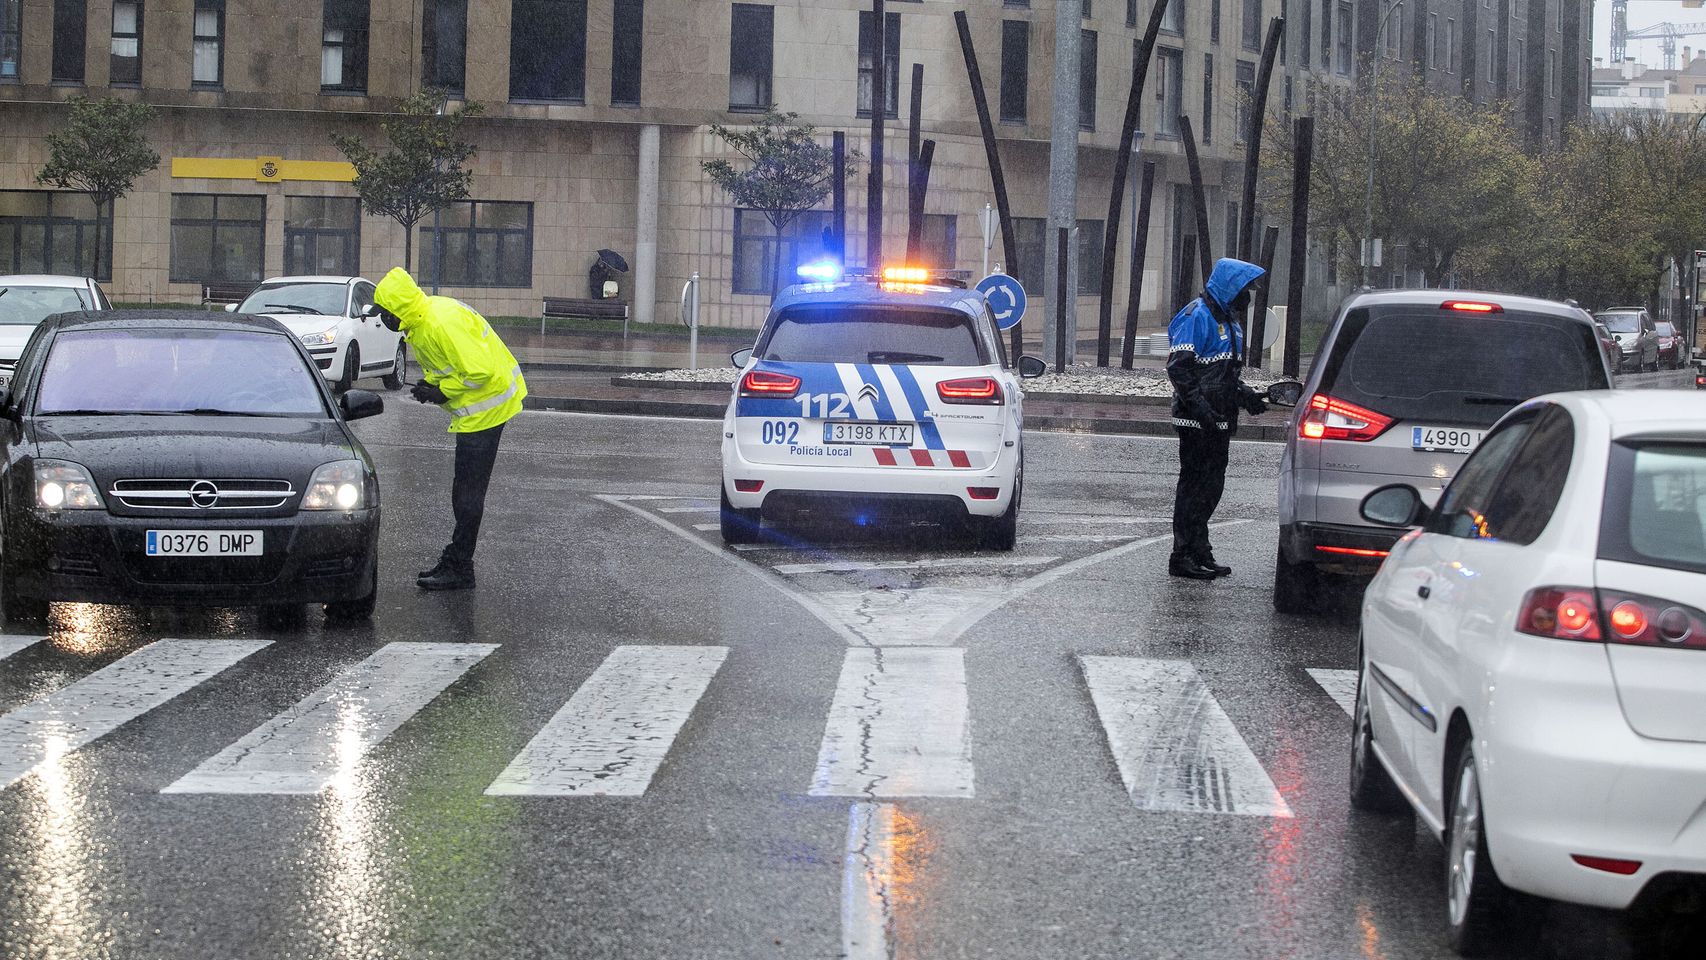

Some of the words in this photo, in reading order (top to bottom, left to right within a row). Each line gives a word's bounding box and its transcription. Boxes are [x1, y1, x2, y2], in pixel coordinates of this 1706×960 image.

[794, 392, 850, 418] 112
[762, 420, 799, 445] 092
[835, 425, 873, 440] 3198
[879, 426, 907, 441] KTX
[1424, 429, 1470, 447] 4990
[790, 445, 823, 456] Policía
[826, 446, 852, 457] Local
[161, 534, 208, 553] 0376
[219, 534, 254, 553] DMP
